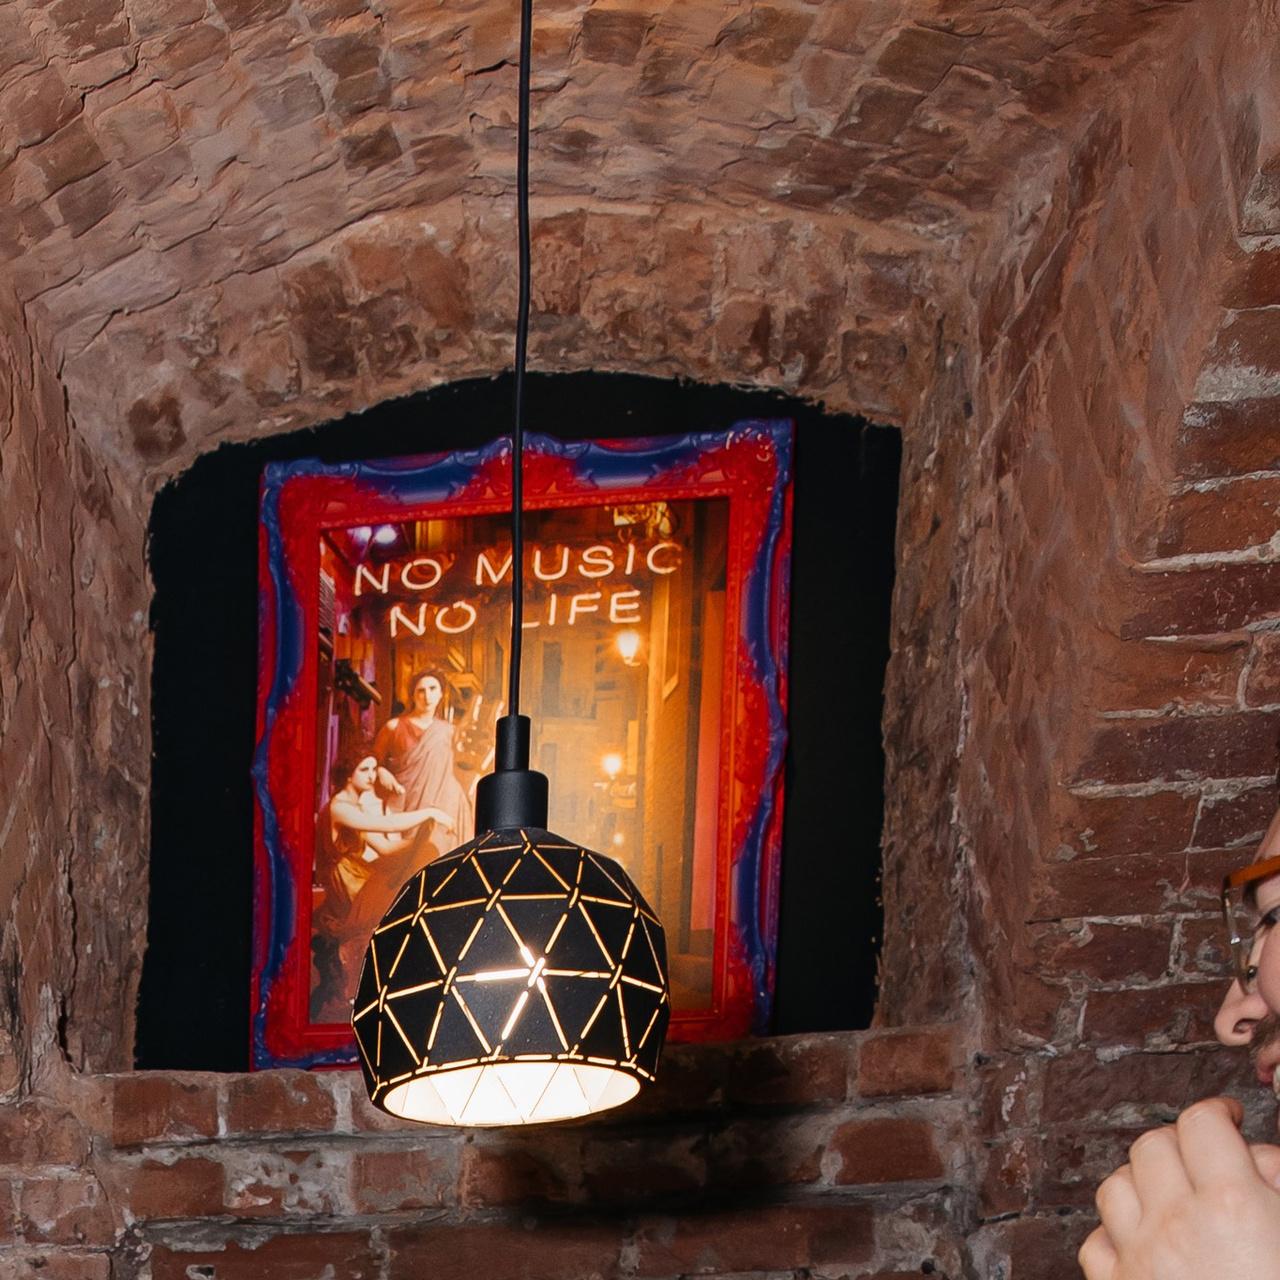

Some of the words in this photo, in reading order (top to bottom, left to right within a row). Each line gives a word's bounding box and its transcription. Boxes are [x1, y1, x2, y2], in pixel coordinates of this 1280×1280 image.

[353, 558, 441, 596] NO
[475, 542, 684, 586] MUSIC
[389, 600, 477, 638] NO
